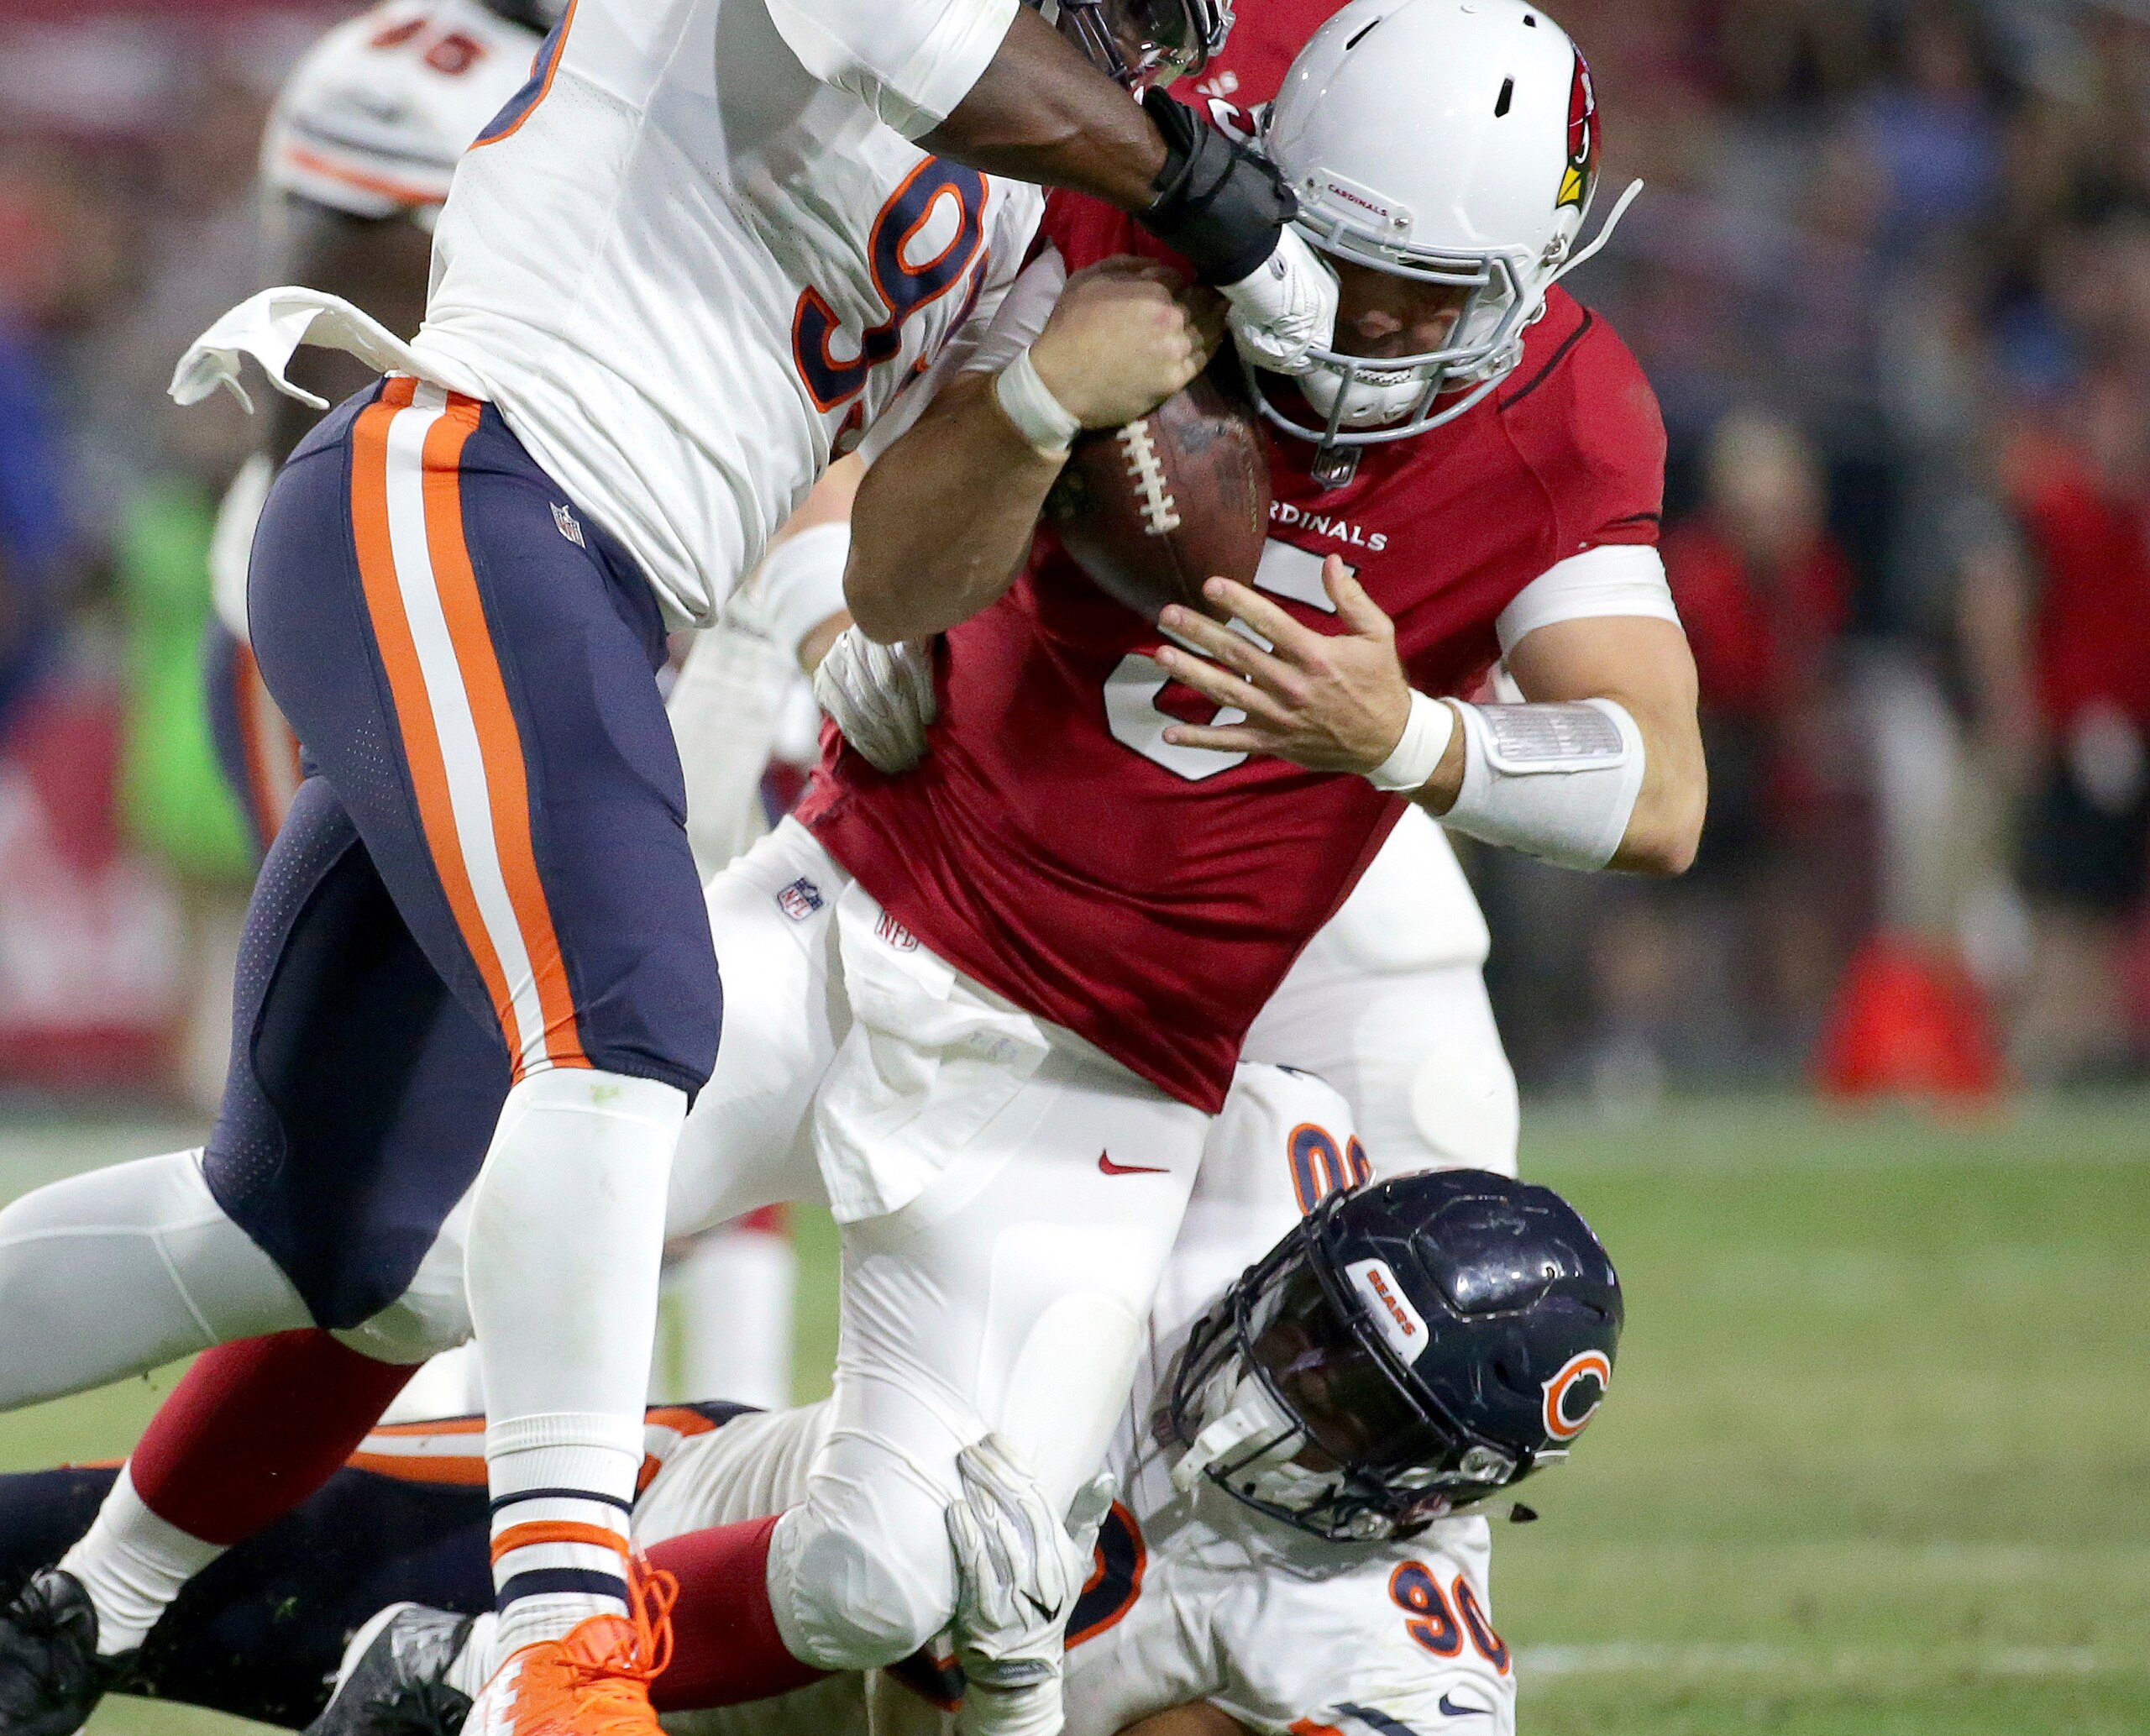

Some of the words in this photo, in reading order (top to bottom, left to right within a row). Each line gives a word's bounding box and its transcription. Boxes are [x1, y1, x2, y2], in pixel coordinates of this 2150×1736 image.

[1328, 183, 1388, 218] CARDINALS
[1268, 499, 1388, 552] RDINALS
[1366, 1268, 1417, 1337] BEARS
[1388, 1560, 1510, 1676] 90
